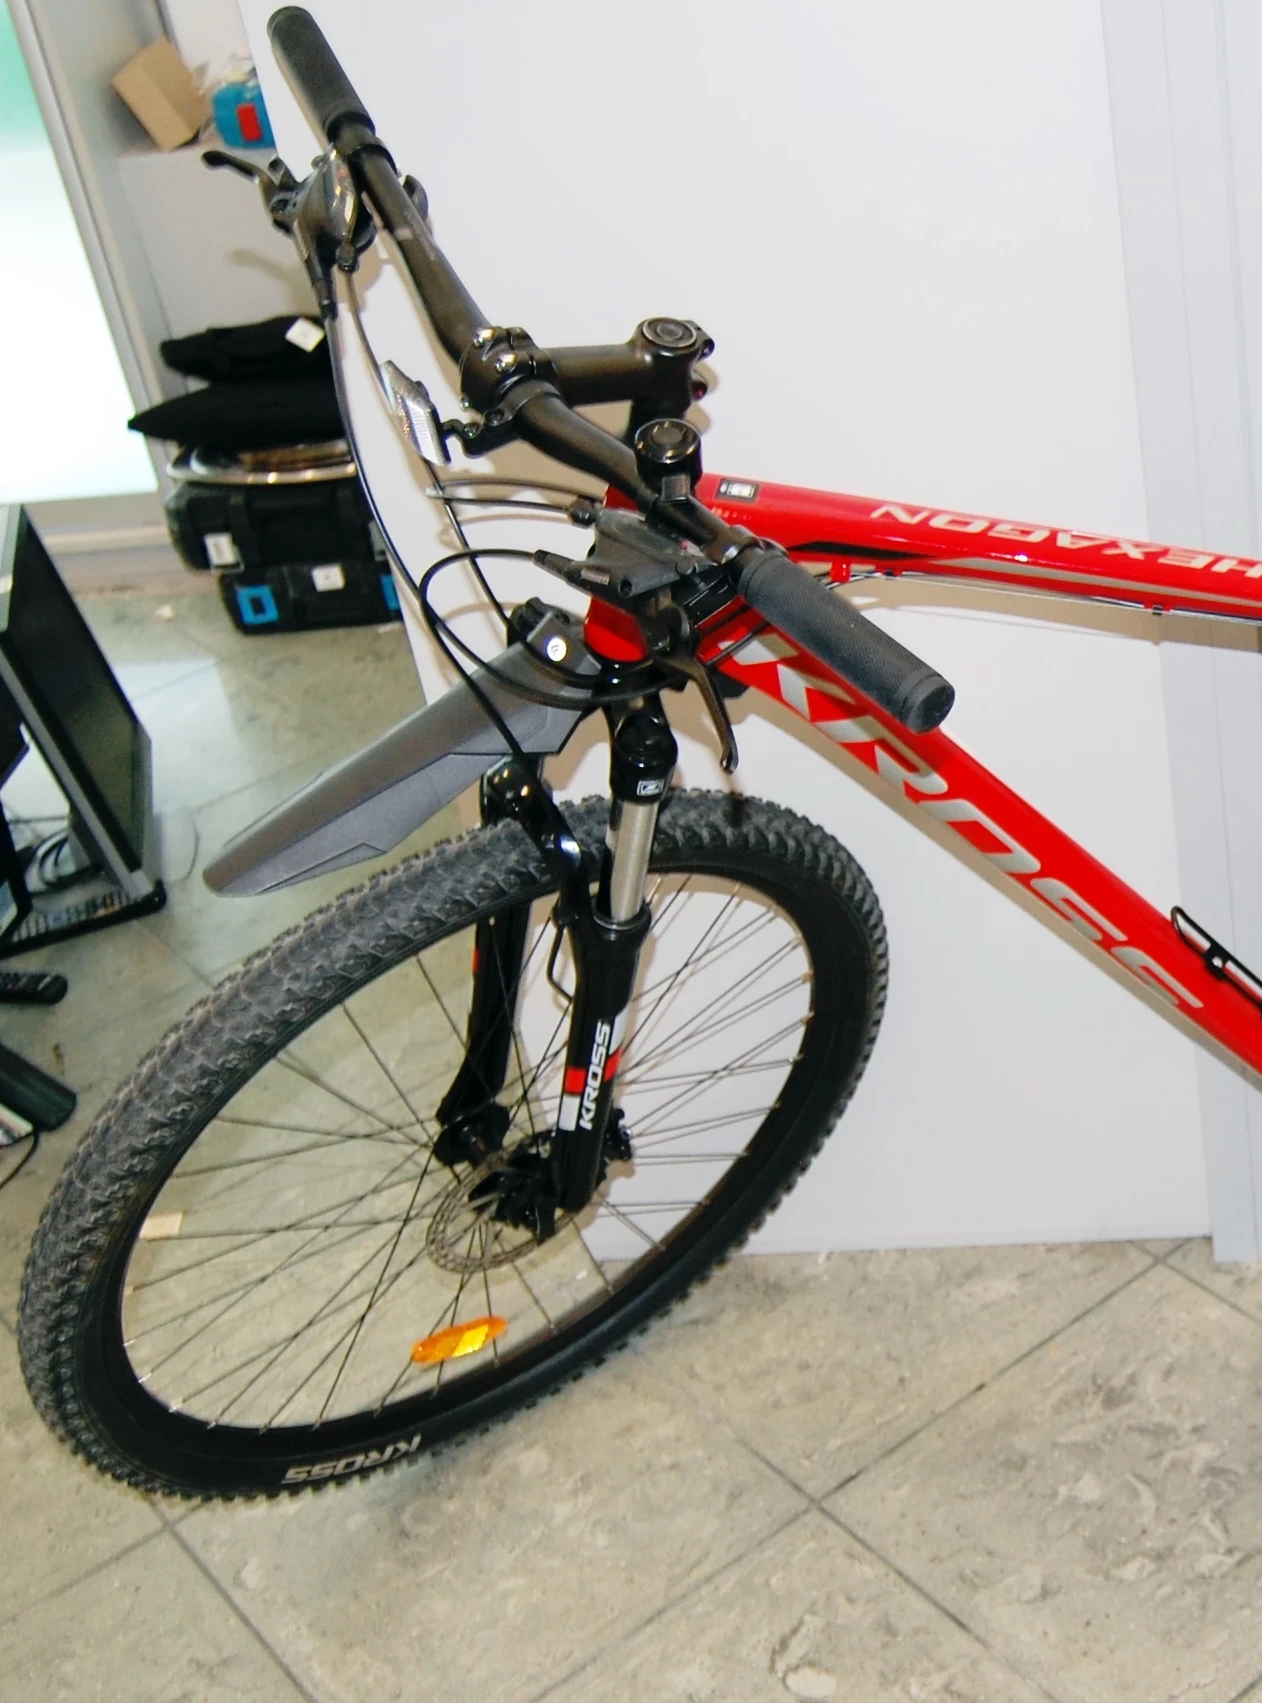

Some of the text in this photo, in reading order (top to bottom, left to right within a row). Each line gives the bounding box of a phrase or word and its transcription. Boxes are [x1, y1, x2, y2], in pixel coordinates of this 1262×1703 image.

[716, 633, 1204, 1009] KROSS
[579, 1019, 611, 1131] KROSS
[280, 1432, 422, 1485] KROSS
